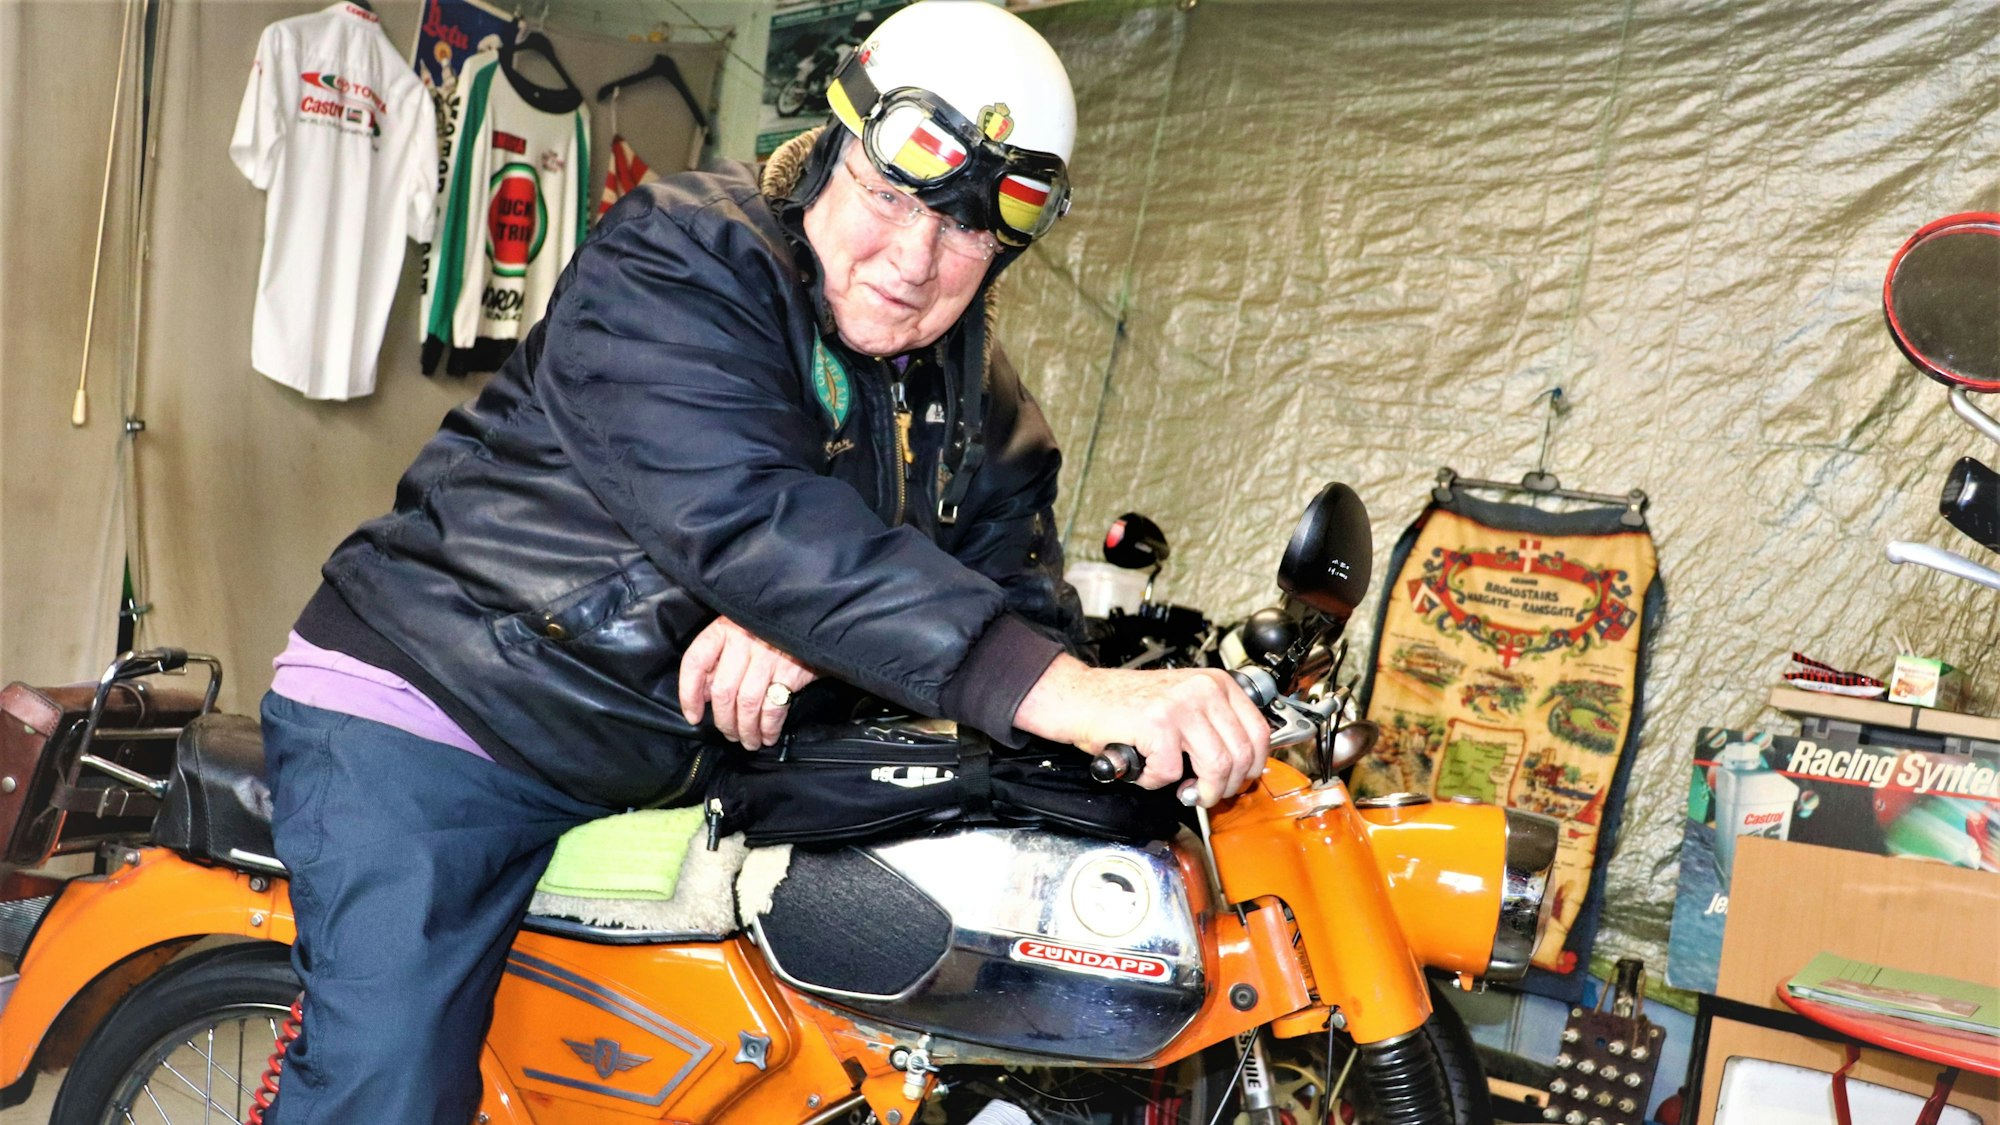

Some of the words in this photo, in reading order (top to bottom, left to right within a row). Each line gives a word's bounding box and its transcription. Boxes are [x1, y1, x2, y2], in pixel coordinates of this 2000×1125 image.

[1485, 581, 1559, 602] BROADSTAIRS
[1521, 602, 1576, 618] RAMSGATE
[1787, 740, 1898, 788] Racing
[1744, 811, 1784, 826] Castrol
[1027, 943, 1155, 973] ZÜNDAPP
